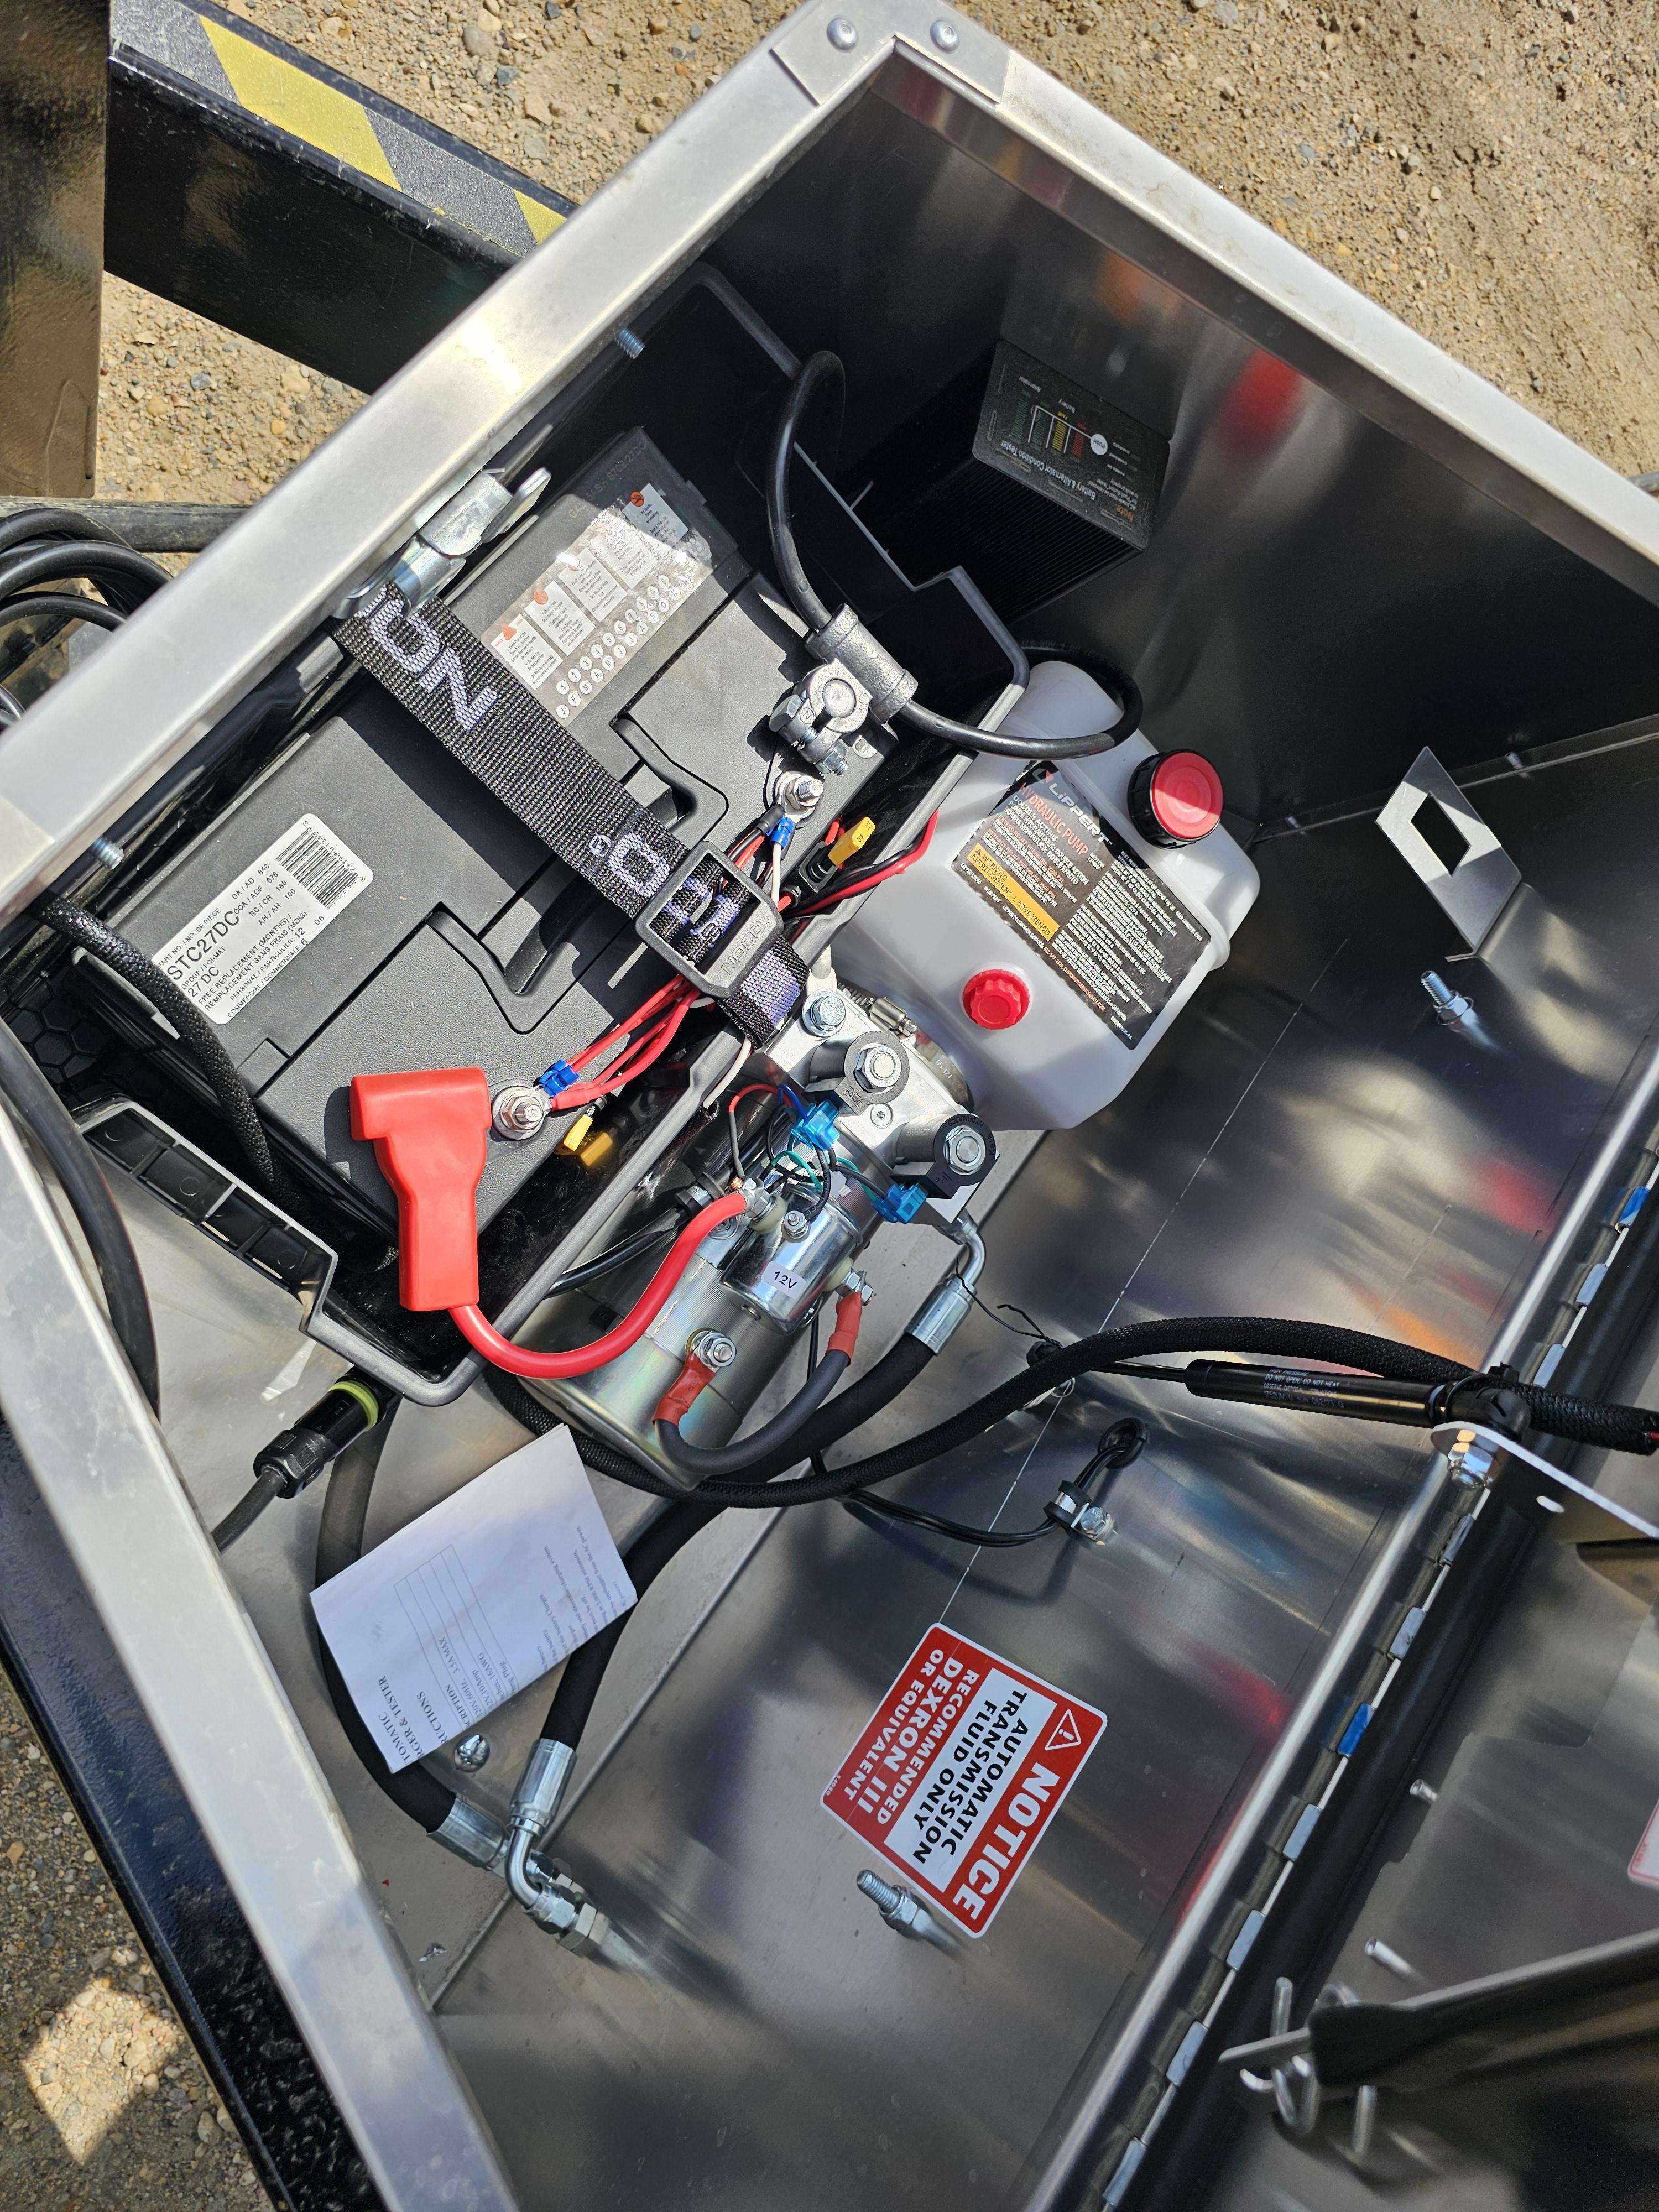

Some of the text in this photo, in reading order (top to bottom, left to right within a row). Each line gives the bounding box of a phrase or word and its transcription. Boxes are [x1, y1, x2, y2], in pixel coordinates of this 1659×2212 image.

[1018, 375, 1041, 393] Alternator
[1058, 398, 1076, 413] Battery
[1093, 438, 1105, 449] PUSH
[999, 439, 1096, 500] Battery & Alternator Condition Tester
[1008, 799, 1026, 820] POMPE
[1053, 847, 1075, 871] DOUBLE
[1072, 866, 1089, 885] ACTION
[1013, 794, 1058, 842] DOUBLE ACTING
[1018, 780, 1089, 858] HYDRAULIC PUMP
[982, 853, 1008, 881] WARNING
[1003, 805, 1022, 826] BOMBA
[1046, 849, 1063, 869] DOBLE
[1061, 864, 1079, 885] EFECTO
[1089, 852, 1104, 869] MOTOR
[231, 889, 242, 900] CA
[243, 877, 255, 888] AD
[233, 900, 248, 915] CCA
[249, 885, 264, 899] ADF
[249, 906, 260, 917] RC
[261, 894, 273, 905] CR
[275, 879, 288, 891] 180
[257, 915, 268, 925] AH
[270, 902, 281, 913] AH
[284, 888, 296, 900] 100
[970, 852, 1051, 937] AVERTISSEMENT ADVERTENCIA
[171, 943, 183, 954] NO.
[185, 931, 196, 942] NO.
[195, 923, 205, 932] DE
[203, 907, 221, 924] PIECE
[314, 915, 325, 926] D5
[164, 909, 242, 982] STC27DC
[180, 969, 201, 989] GROUP
[202, 946, 226, 968] FORMAT
[197, 987, 216, 1005] FREE
[213, 945, 260, 989] REPLACEMENT
[257, 916, 290, 948] (MONTHS)
[204, 910, 309, 1011] REMPLACEMENT SANS FRAIS (MOIS)
[229, 973, 259, 1001] PERSONAL
[259, 936, 296, 972] PARTICULIER:
[293, 926, 306, 939] 12
[720, 921, 766, 974] NOCO
[187, 964, 220, 997] 27 DC
[226, 984, 262, 1018] COMMERCIAL
[263, 943, 303, 982] COMMERCIALE:
[300, 938, 309, 946] 6
[947, 1116, 984, 1128] HYDRAULICS
[775, 1271, 797, 1288] 12V
[437, 1636, 453, 1657] MAX
[497, 1660, 512, 1678] Plug
[376, 1676, 404, 1718] TESTER
[378, 1710, 413, 1766] TOMATIC
[398, 1717, 408, 1728] &
[841, 1647, 945, 1801] OR EQUIVALENT
[856, 1656, 964, 1814] DEXRON III
[873, 1668, 980, 1827] RECOMMENDED
[910, 1699, 998, 1831] FLUID ONLY
[911, 1687, 1028, 1864] TRANSMISSION
[940, 1718, 1032, 1856] AUTOMATIC
[951, 1762, 1061, 1921] NOTICE
